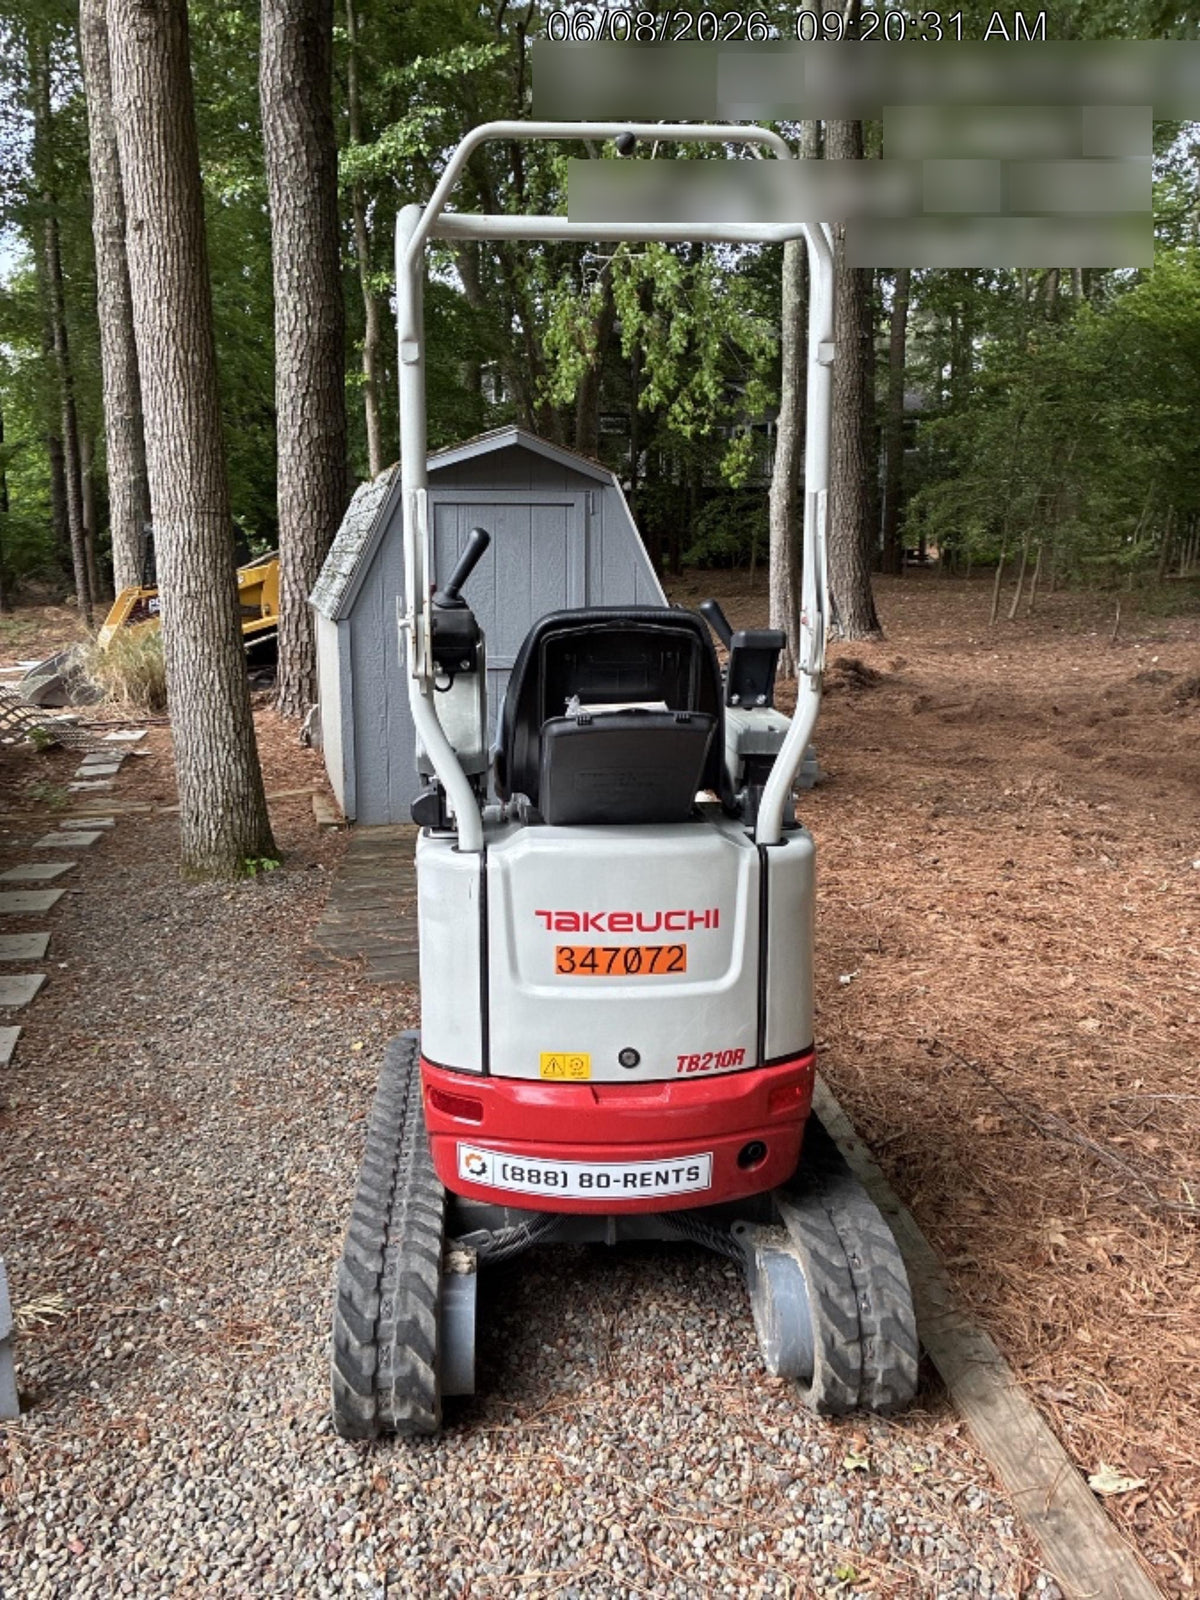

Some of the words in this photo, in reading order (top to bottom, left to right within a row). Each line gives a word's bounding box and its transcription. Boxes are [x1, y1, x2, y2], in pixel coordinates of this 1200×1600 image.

[557, 946, 684, 974] 347072
[676, 1048, 746, 1073] TB210R
[502, 1163, 568, 1188] (888)
[579, 1166, 700, 1188] 80-RENTS
